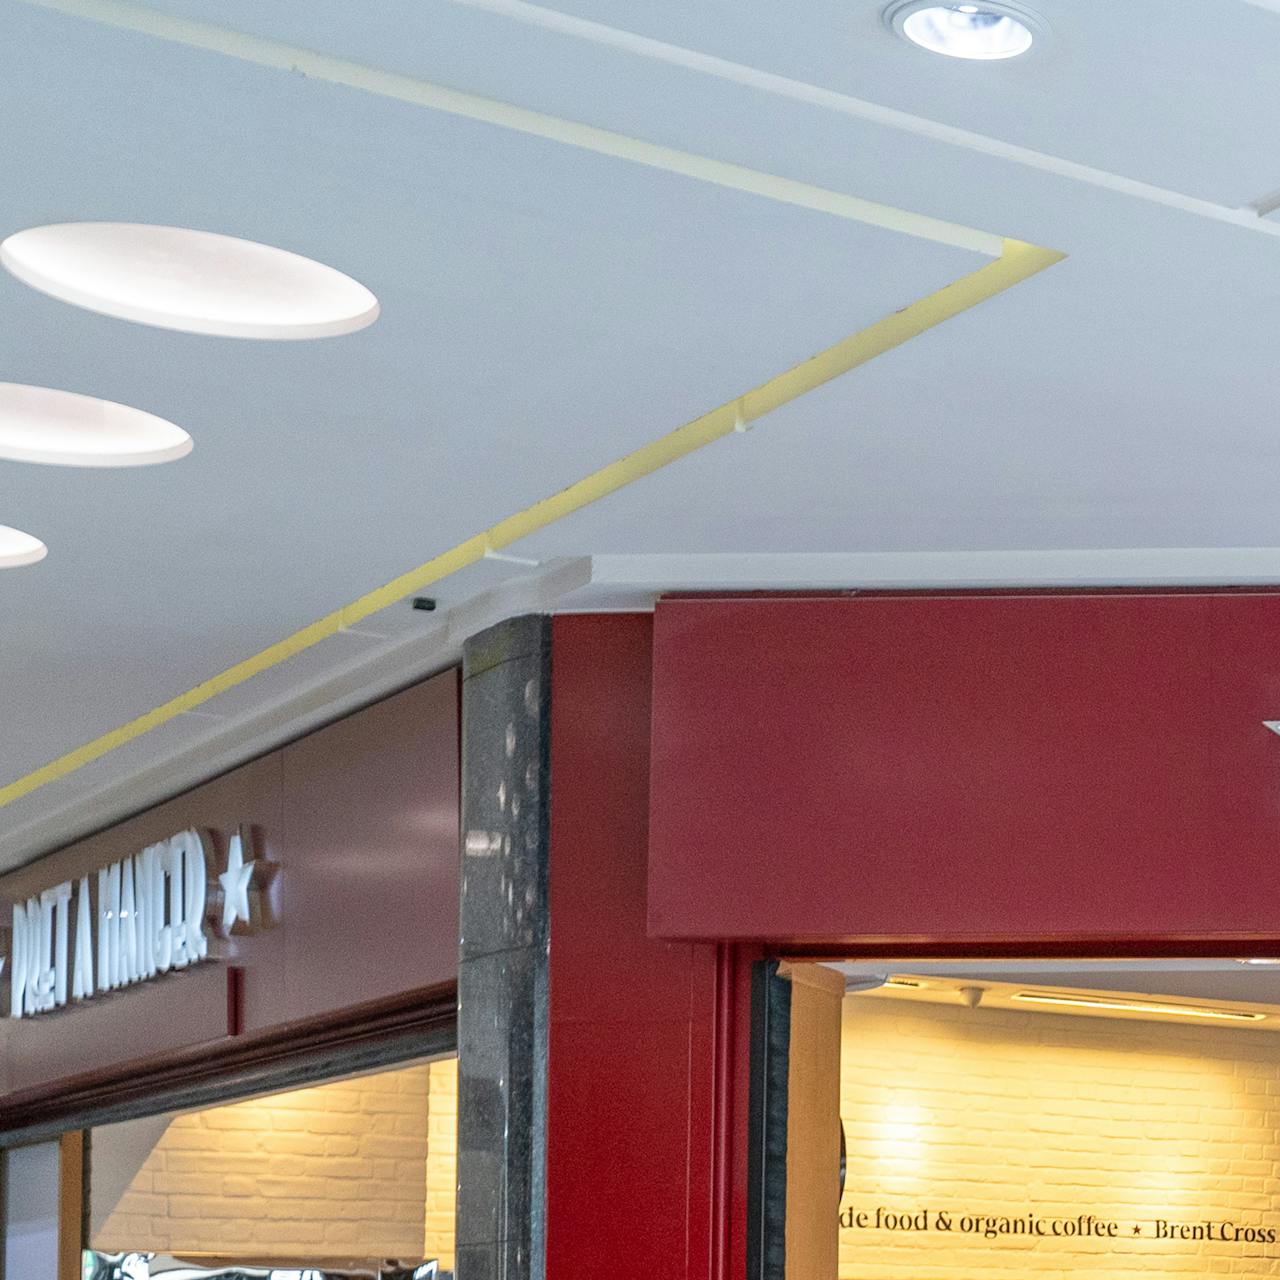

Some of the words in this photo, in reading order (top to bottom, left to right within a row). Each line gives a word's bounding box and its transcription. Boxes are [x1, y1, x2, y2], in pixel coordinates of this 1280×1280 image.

[875, 1207, 928, 1231] food
[935, 1211, 953, 1231] &
[960, 1213, 1047, 1239] organic
[1052, 1214, 1118, 1237] coffee
[1155, 1219, 1215, 1240] Brent
[1220, 1222, 1276, 1243] Cross
